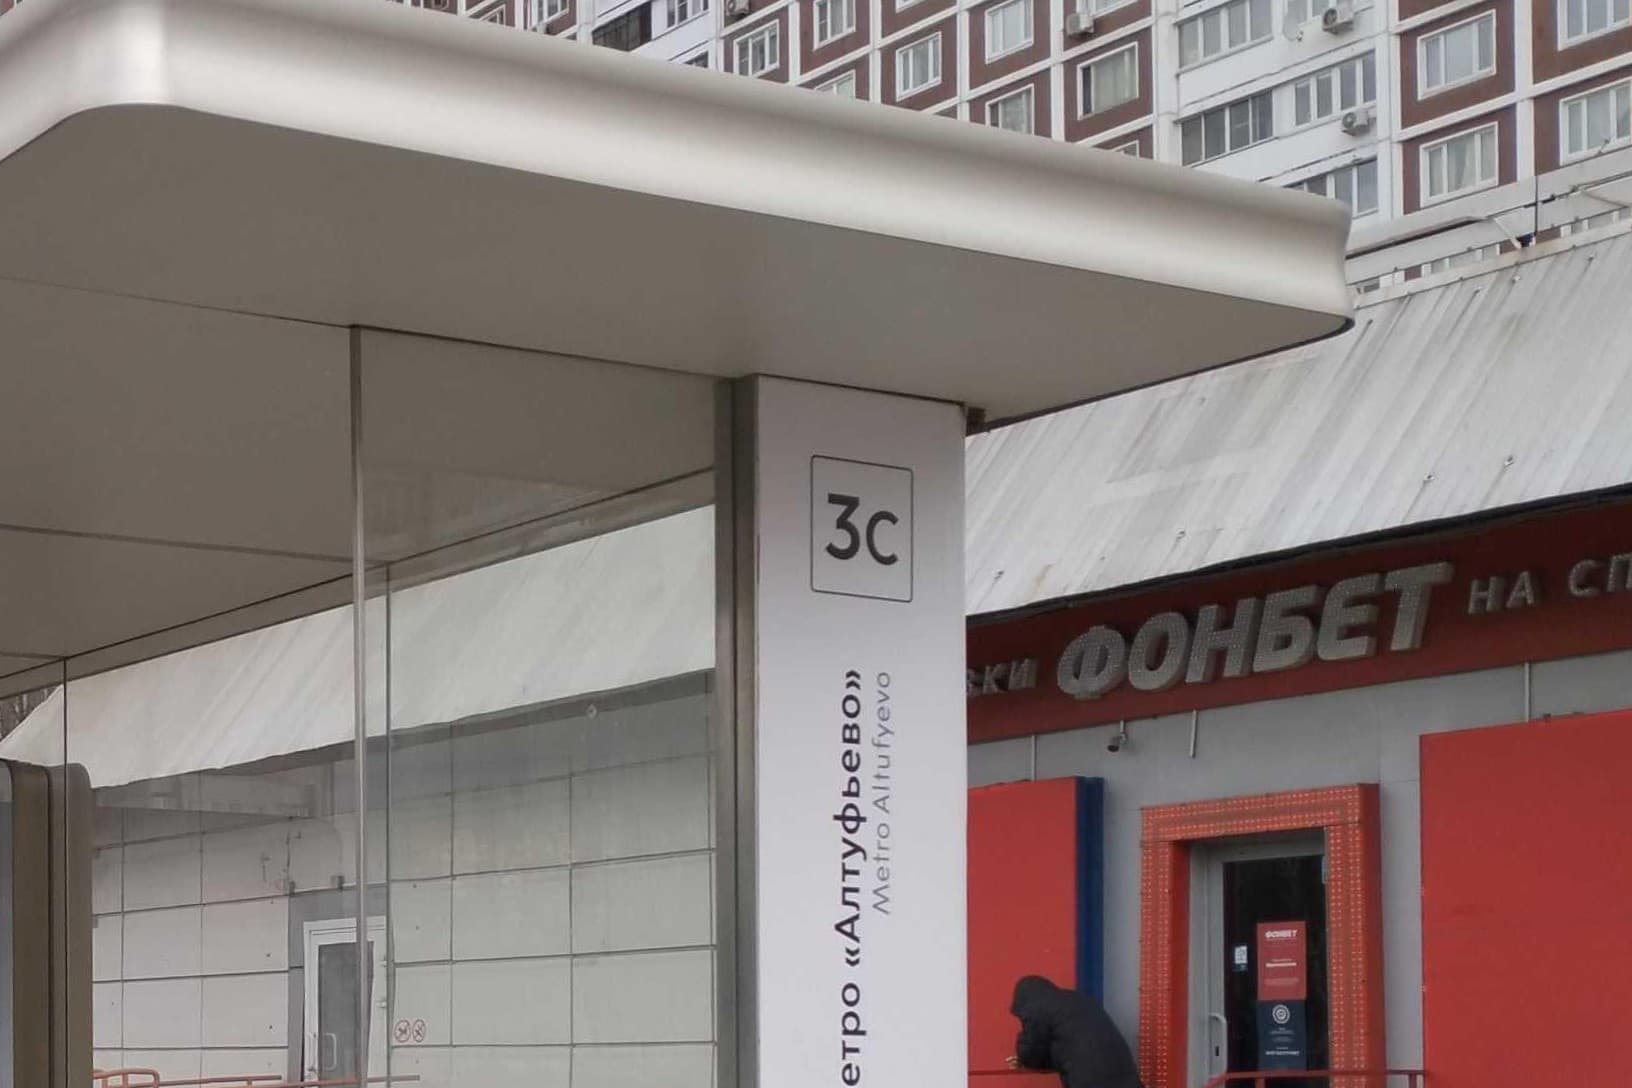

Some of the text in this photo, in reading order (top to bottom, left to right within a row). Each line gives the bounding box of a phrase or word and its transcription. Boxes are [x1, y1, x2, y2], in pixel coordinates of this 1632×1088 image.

[1056, 561, 1453, 699] ФОНБЕТ
[1468, 570, 1539, 616] НА
[832, 668, 867, 968] «Алтуфьево»
[871, 671, 895, 915] Metro Altufyevo
